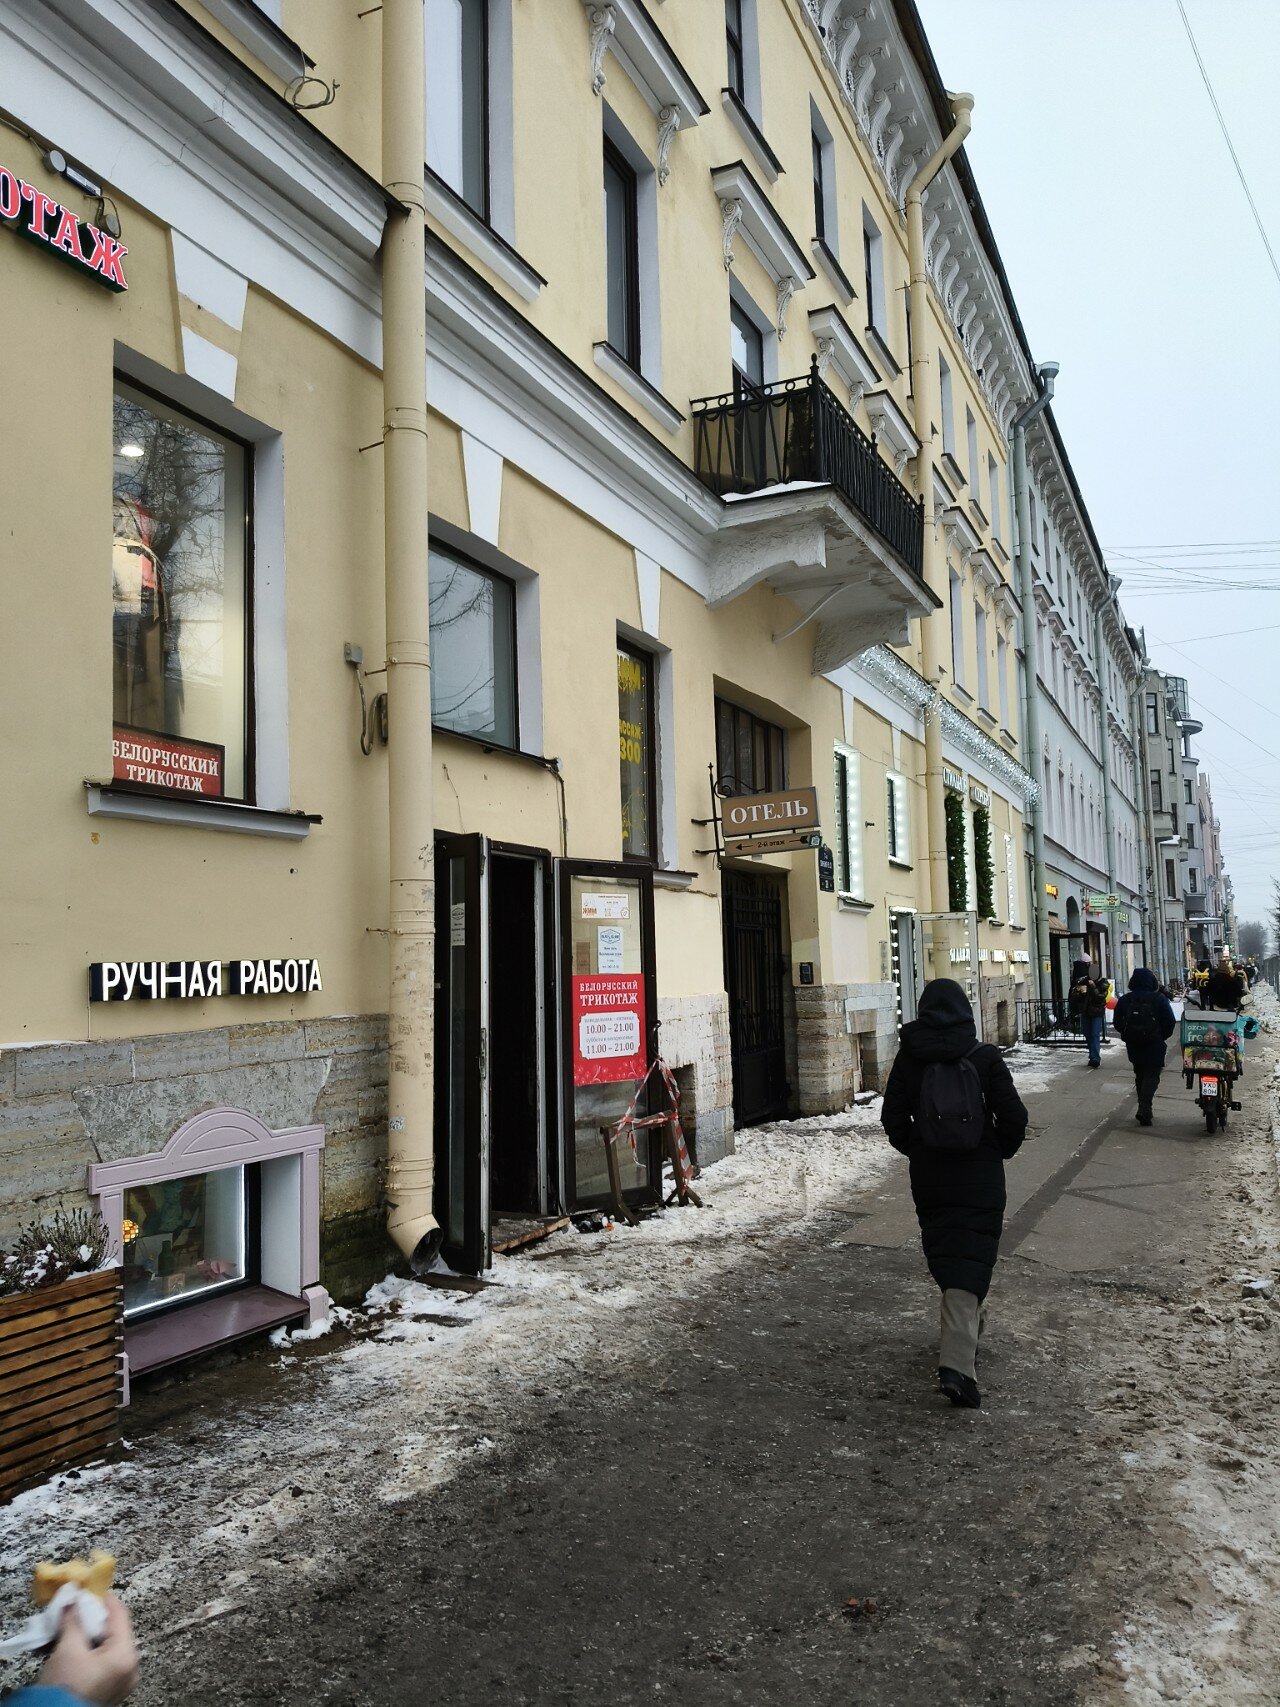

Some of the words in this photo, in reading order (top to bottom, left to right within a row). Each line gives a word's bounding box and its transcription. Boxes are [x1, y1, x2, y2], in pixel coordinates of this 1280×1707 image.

[113, 740, 218, 776] БЕЛОРУССКИЙ
[127, 765, 203, 792] ТРИКОТАЖ
[730, 799, 808, 824] ОТЕЛЬ
[102, 960, 221, 1001] РУЧНАЯ
[240, 959, 322, 994] РАБОТА
[579, 980, 638, 992] БЕЛОРУССКИЙ
[579, 992, 638, 1007] ТРИКОТАЖ
[586, 1024, 606, 1034] 10.00
[613, 1023, 634, 1032] 21.00
[1187, 1031, 1217, 1042] fresh
[586, 1043, 607, 1054] 11.00
[614, 1042, 635, 1052] 21.00
